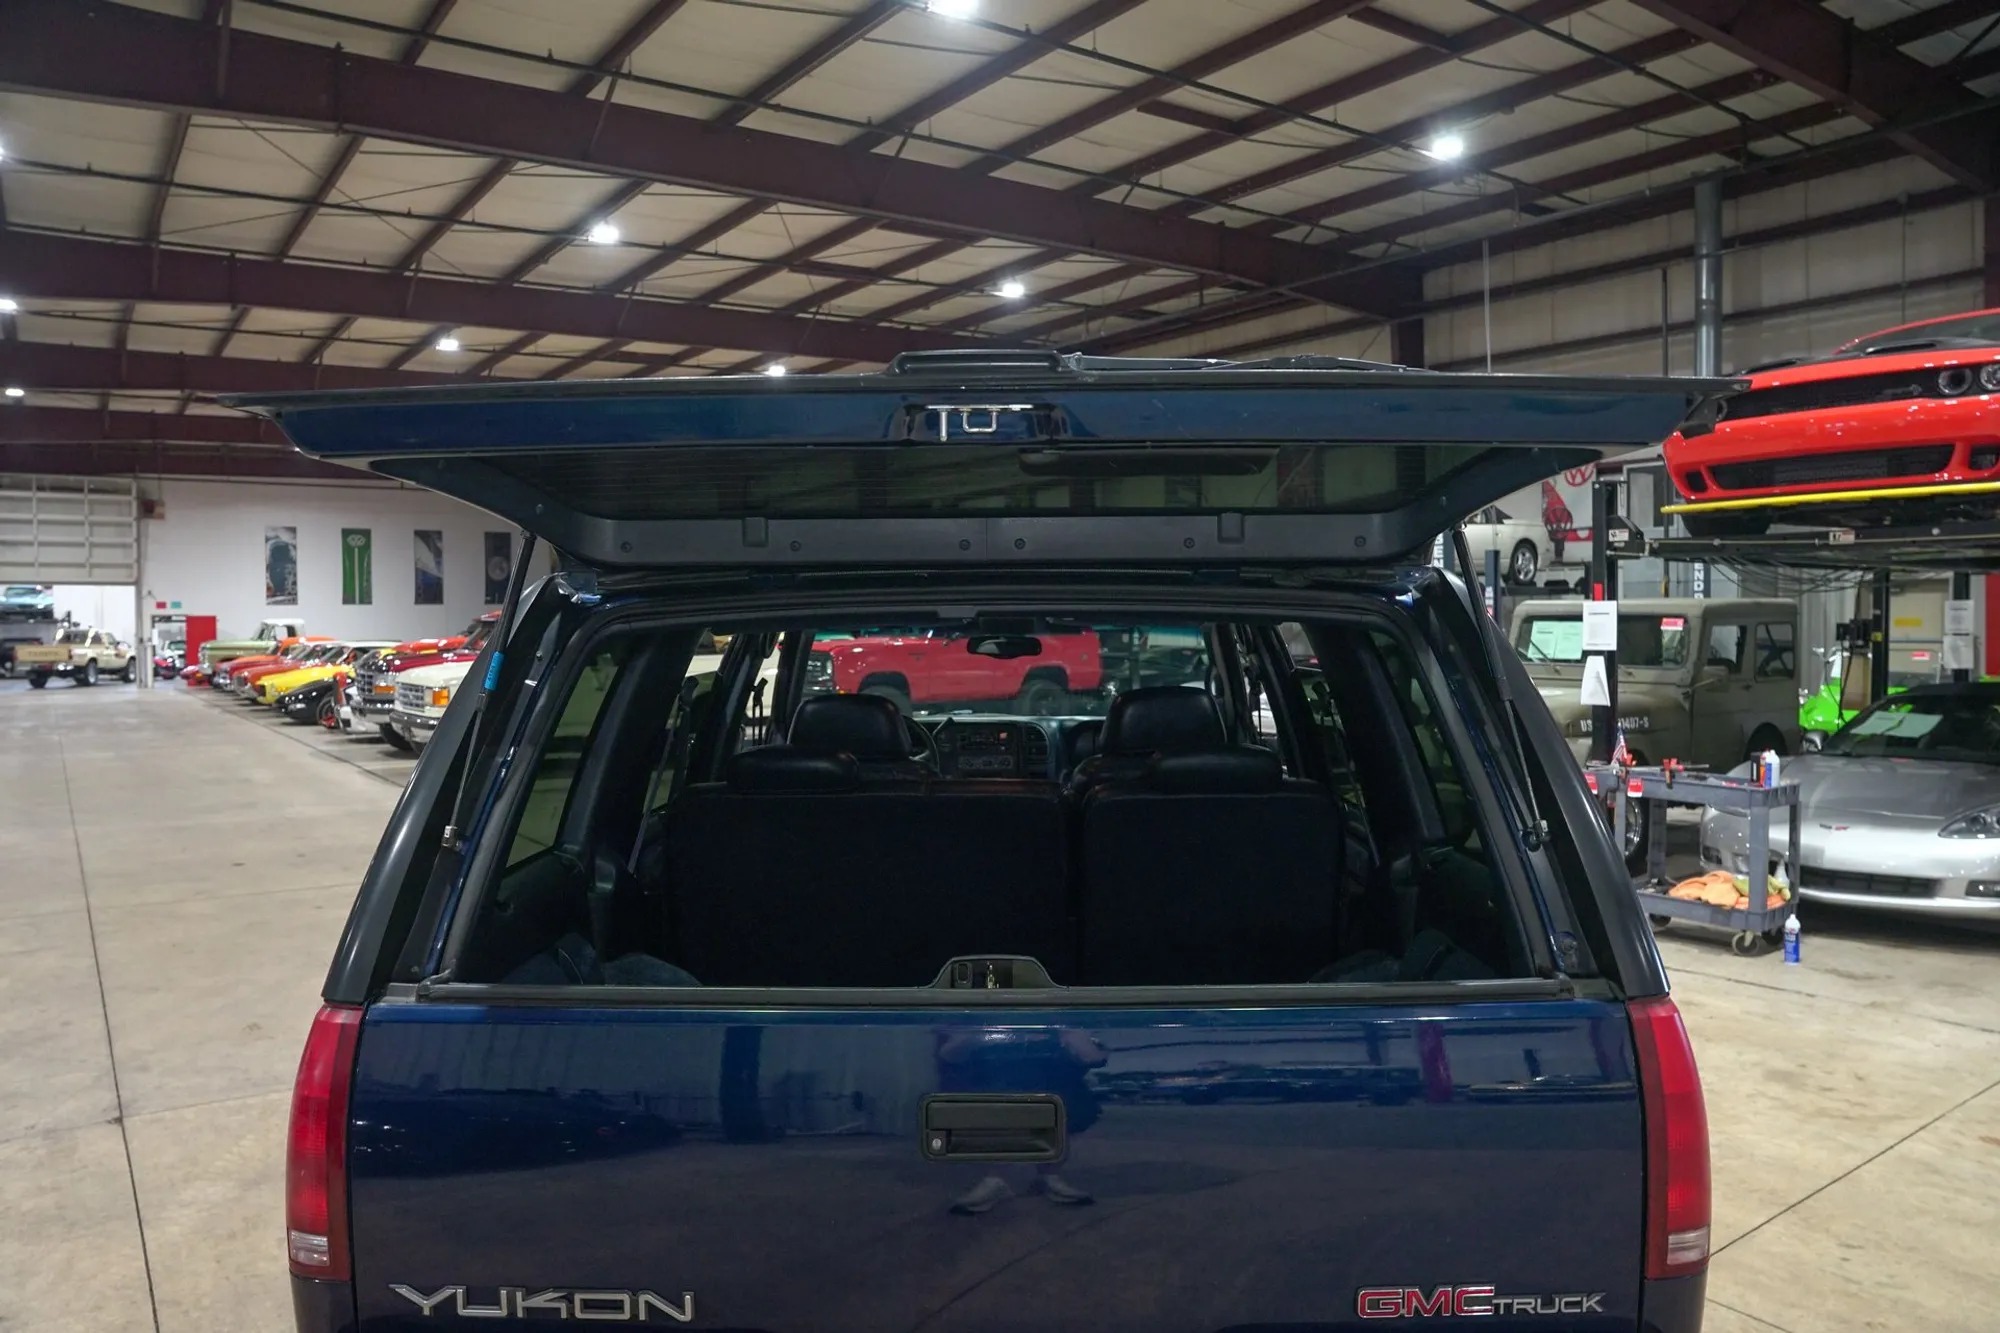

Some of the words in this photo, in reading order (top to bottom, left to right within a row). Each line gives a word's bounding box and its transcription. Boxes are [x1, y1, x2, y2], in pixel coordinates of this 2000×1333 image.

[388, 1283, 695, 1322] YUKON
[1357, 1283, 1496, 1319] GMC
[1492, 1292, 1606, 1315] TRUCK
